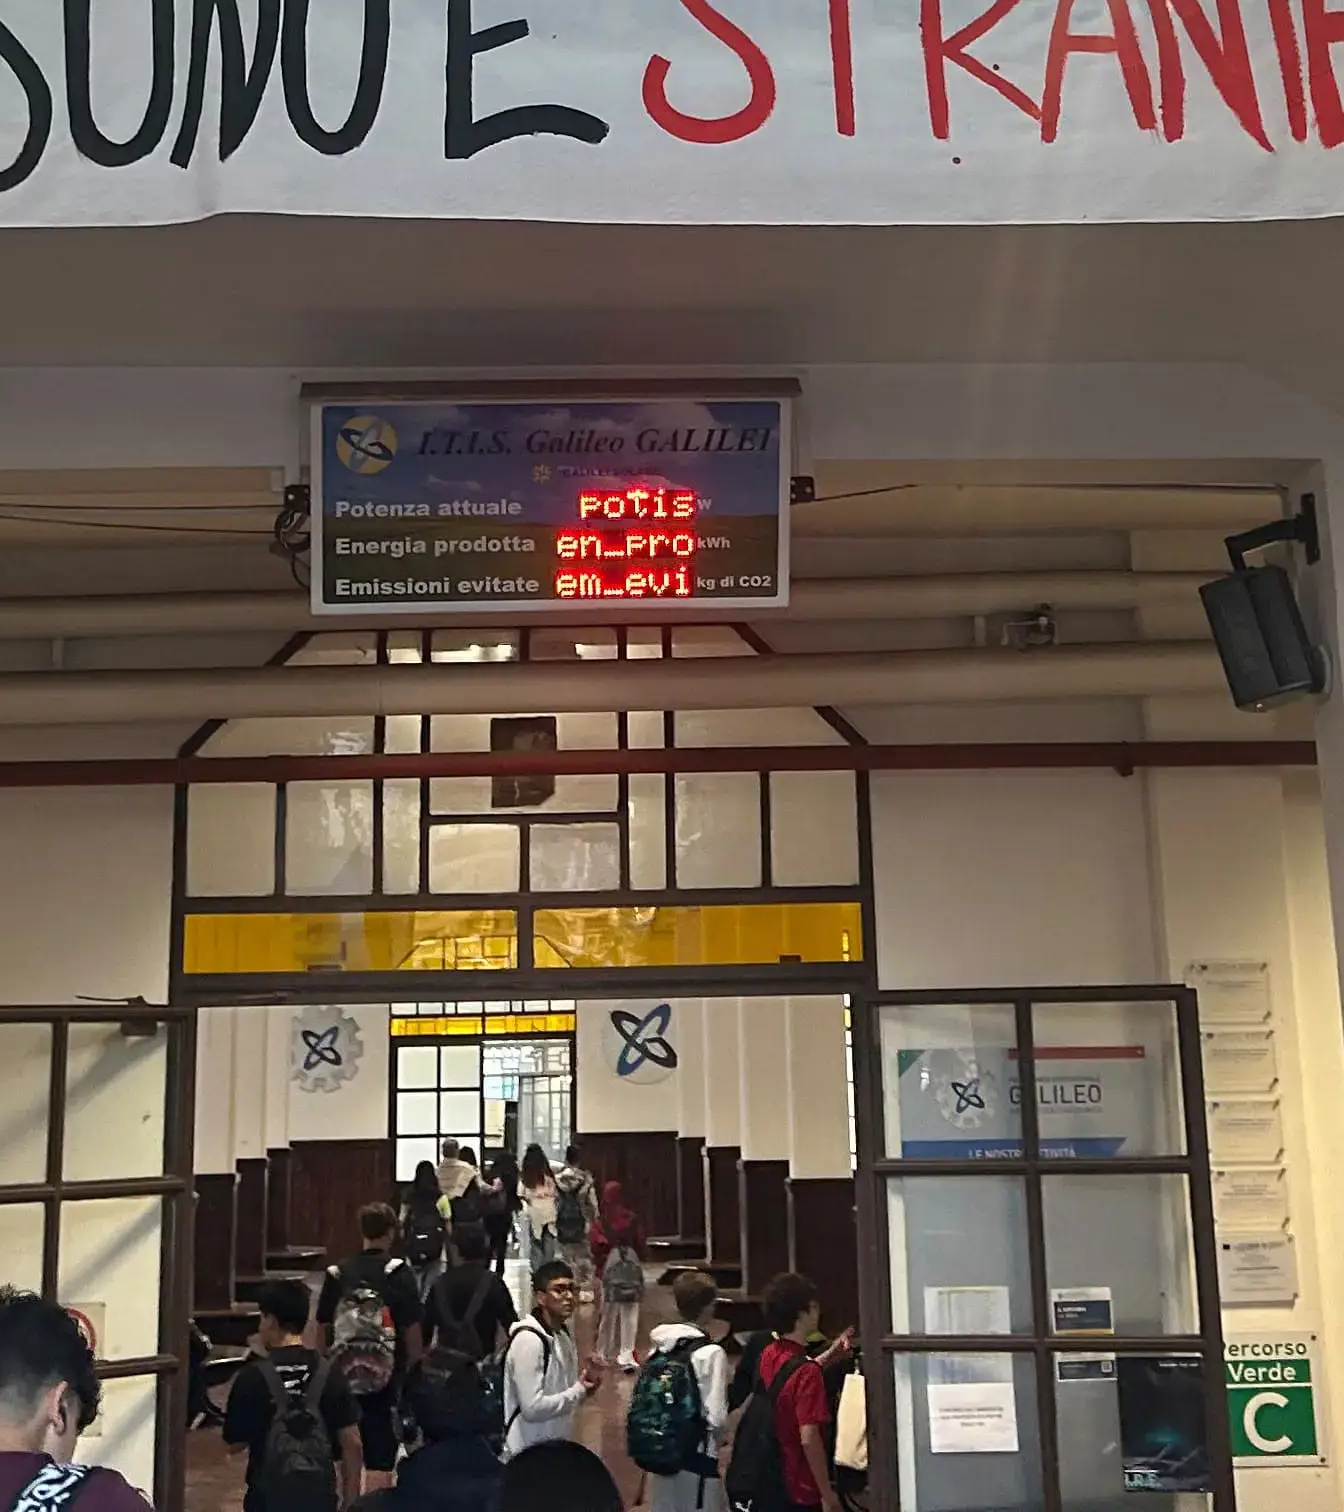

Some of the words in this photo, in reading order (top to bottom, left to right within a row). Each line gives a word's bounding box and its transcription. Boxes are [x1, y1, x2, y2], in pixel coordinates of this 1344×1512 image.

[414, 428, 511, 456] I.T.I.S.
[526, 428, 624, 455] Galileo
[636, 426, 771, 453] GALILEI
[335, 500, 431, 518] Potenza
[438, 498, 523, 516] attuale
[335, 536, 427, 559] Energia
[434, 535, 536, 557] prodotta
[697, 537, 731, 549] kWh
[335, 576, 451, 596] Emissioni
[457, 576, 540, 594] evitate
[696, 576, 716, 591] kg
[720, 575, 735, 588] di
[739, 575, 772, 588] CO2
[1009, 1084, 1102, 1105] GLILEO
[985, 1148, 1024, 1160] NOSTR
[1226, 1342, 1308, 1357] ercorso
[1227, 1363, 1297, 1382] Verde
[1243, 1391, 1294, 1453] C
